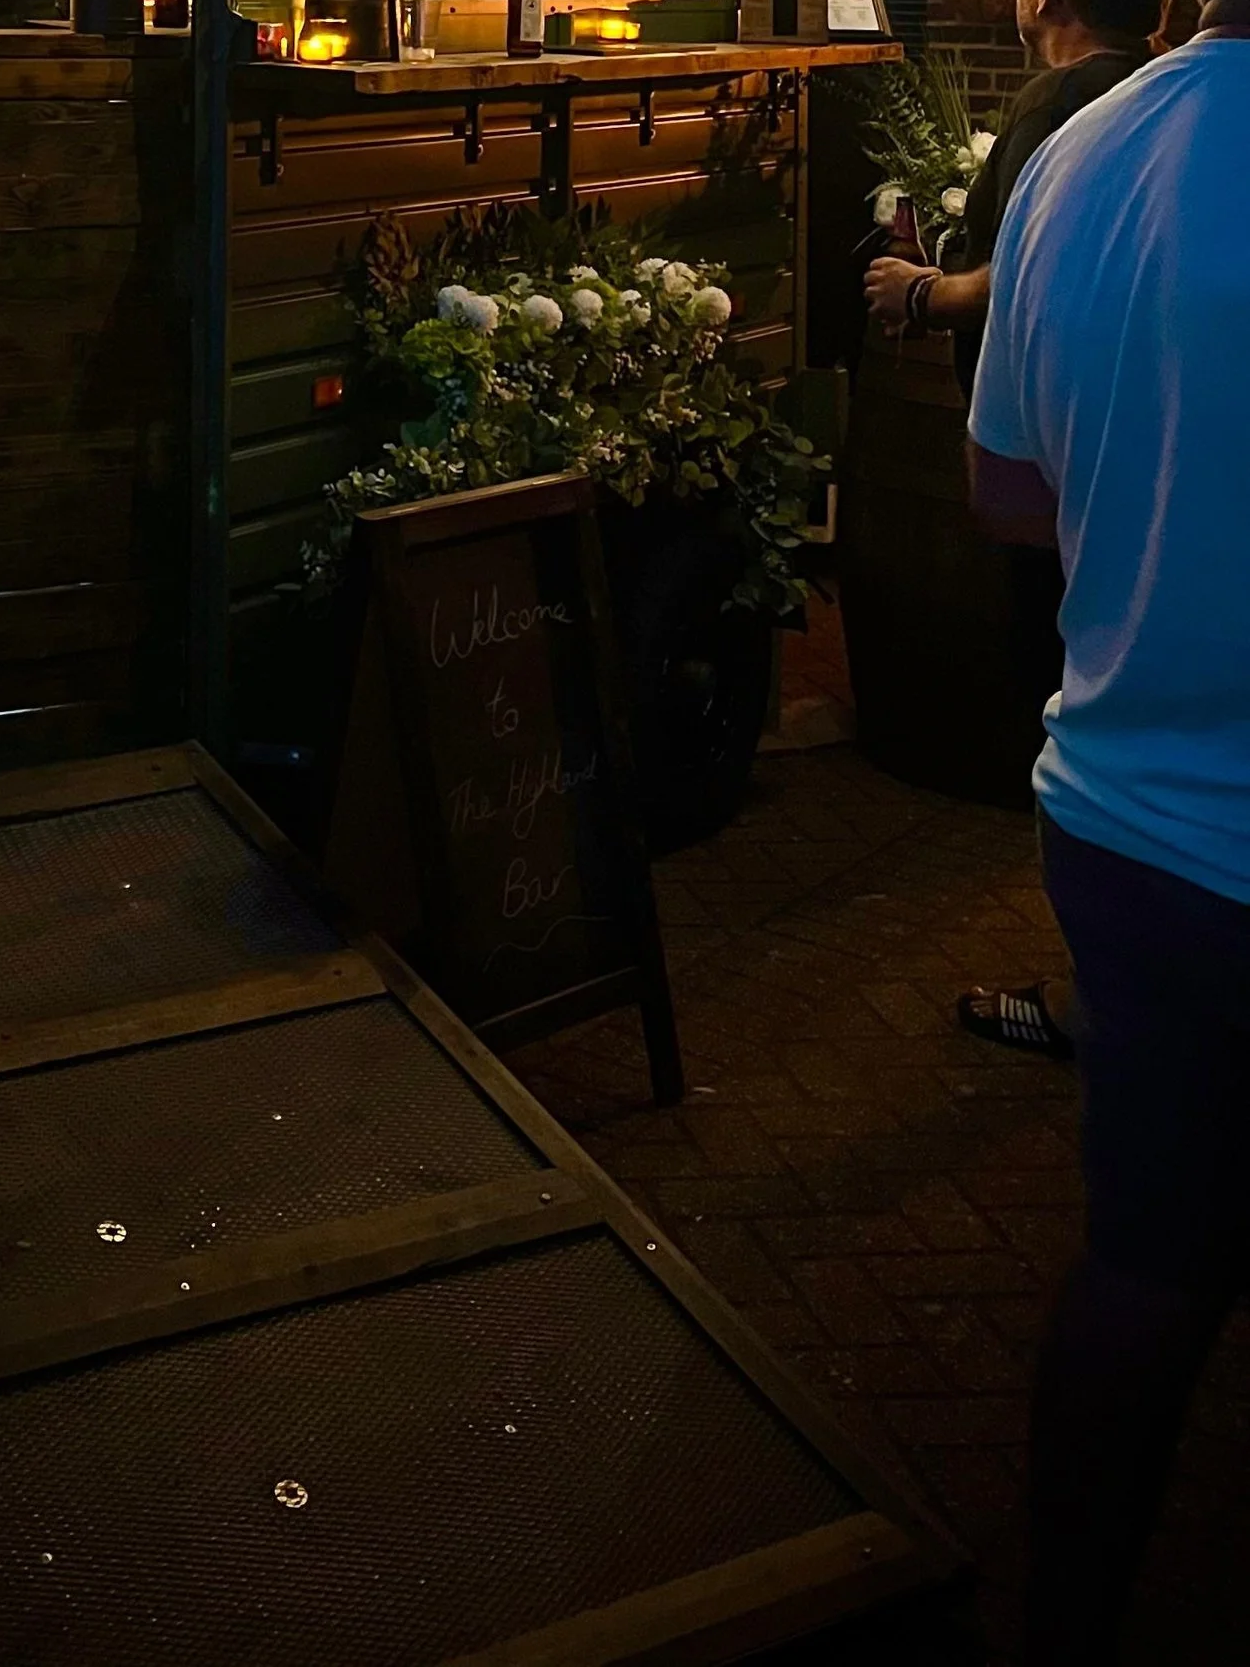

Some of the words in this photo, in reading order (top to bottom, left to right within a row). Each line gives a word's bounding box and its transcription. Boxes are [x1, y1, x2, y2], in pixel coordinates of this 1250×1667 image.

[431, 584, 574, 669] Welcome
[485, 677, 519, 739] to
[448, 782, 495, 831] The
[501, 857, 574, 919] Bar
